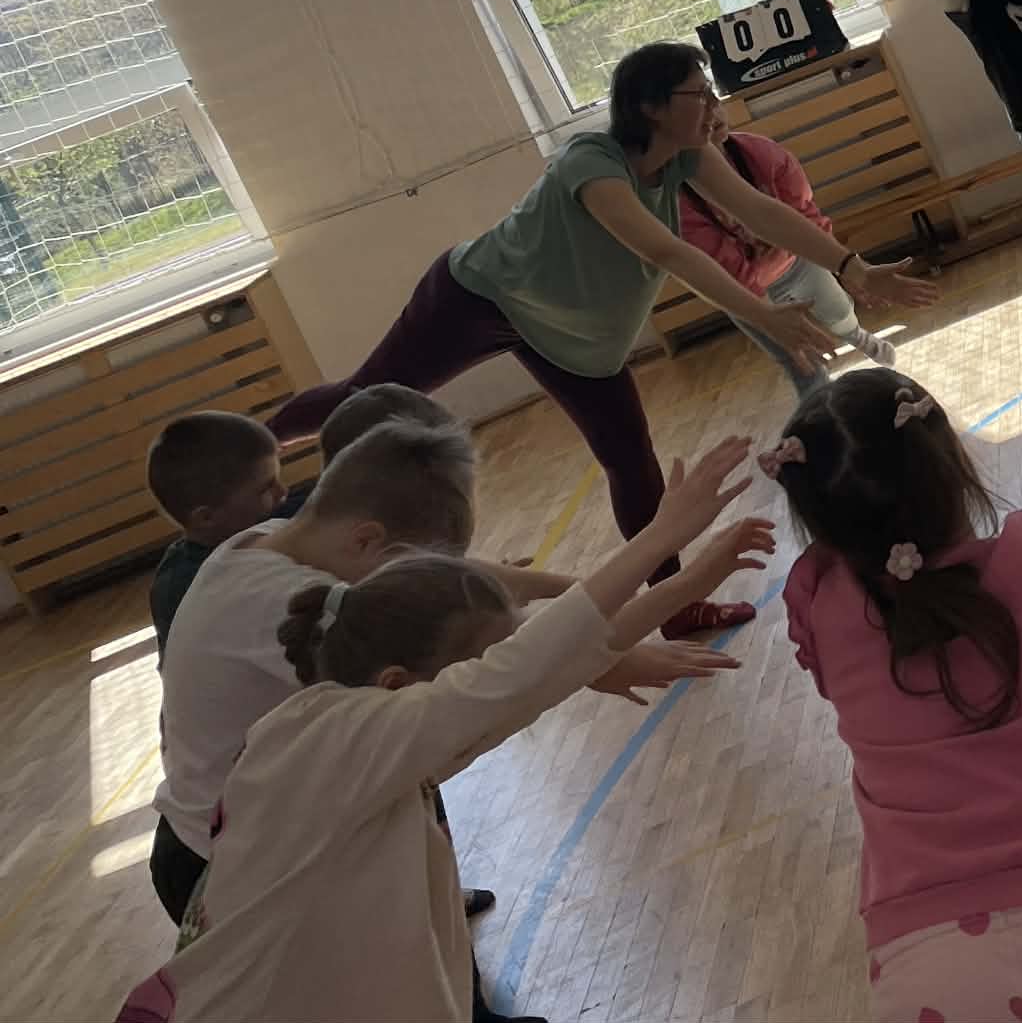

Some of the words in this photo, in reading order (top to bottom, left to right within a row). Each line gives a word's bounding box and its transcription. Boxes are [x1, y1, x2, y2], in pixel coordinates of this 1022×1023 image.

[734, 20, 754, 52] 0
[773, 7, 795, 39] 0
[753, 60, 782, 78] sport
[783, 52, 807, 69] plus
